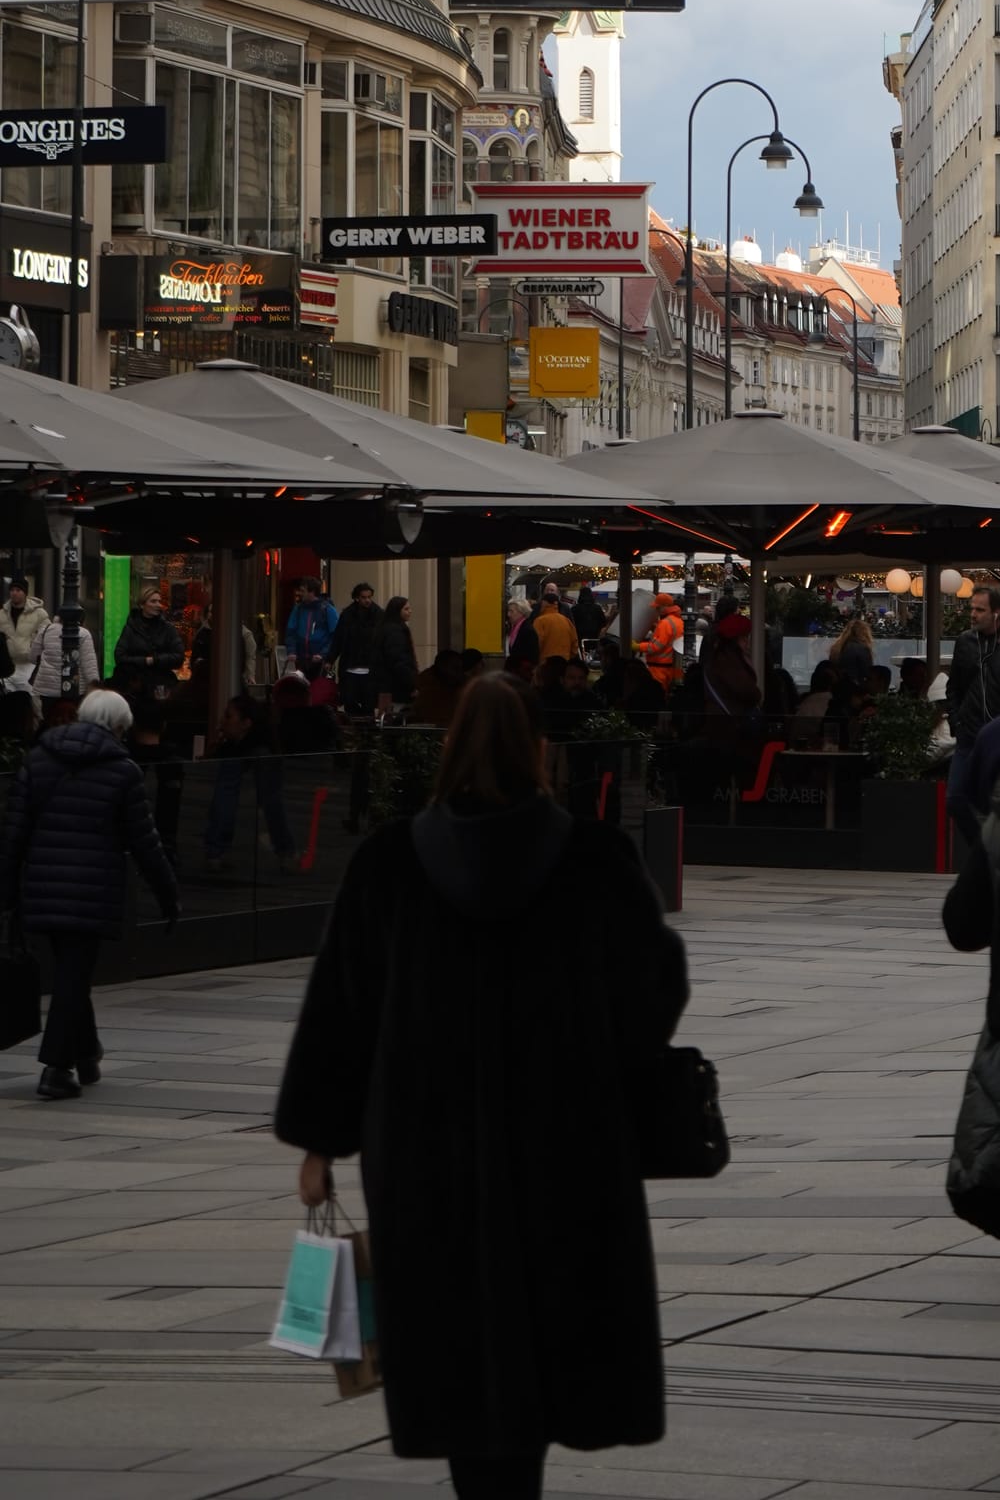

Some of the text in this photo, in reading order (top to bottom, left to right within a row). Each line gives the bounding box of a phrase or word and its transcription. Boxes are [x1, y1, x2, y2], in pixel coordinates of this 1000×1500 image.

[0, 118, 126, 143] ONGINES
[508, 208, 612, 227] WIENER
[329, 226, 486, 247] GERRY WEBER
[498, 231, 639, 250] TADTBRÄU
[13, 248, 89, 288] LONGINS
[170, 260, 264, 286] Tuchlauben
[523, 284, 596, 293] RESTAURANT
[212, 304, 255, 312] sandwiches
[261, 303, 291, 312] desserts
[145, 314, 168, 322] frozen
[168, 315, 193, 324] yogurt
[538, 354, 592, 363] L'OCCITANE
[766, 787, 829, 804] GRABEN
